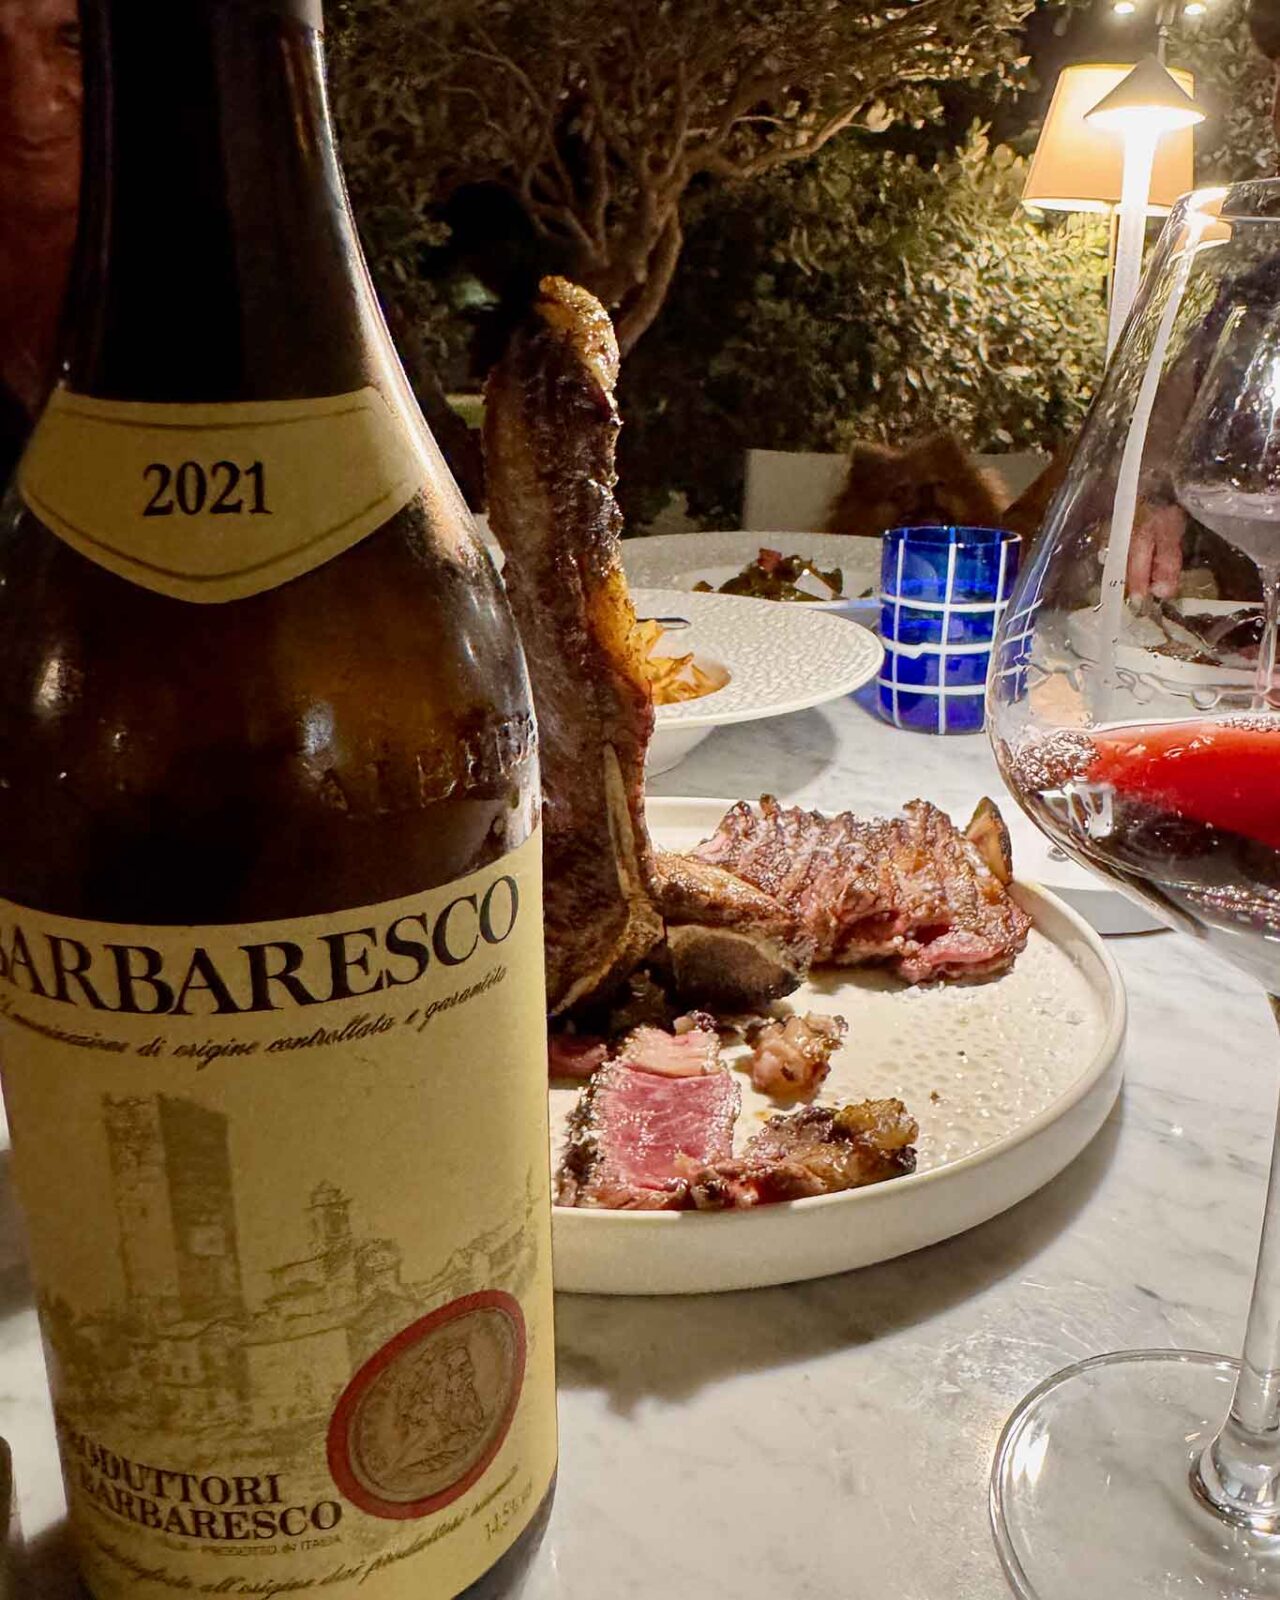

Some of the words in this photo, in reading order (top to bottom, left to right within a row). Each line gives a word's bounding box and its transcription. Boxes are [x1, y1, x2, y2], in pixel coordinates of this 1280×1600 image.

[143, 460, 273, 516] 2021
[172, 1037, 260, 1072] origine
[68, 1430, 288, 1506] DUTTORI
